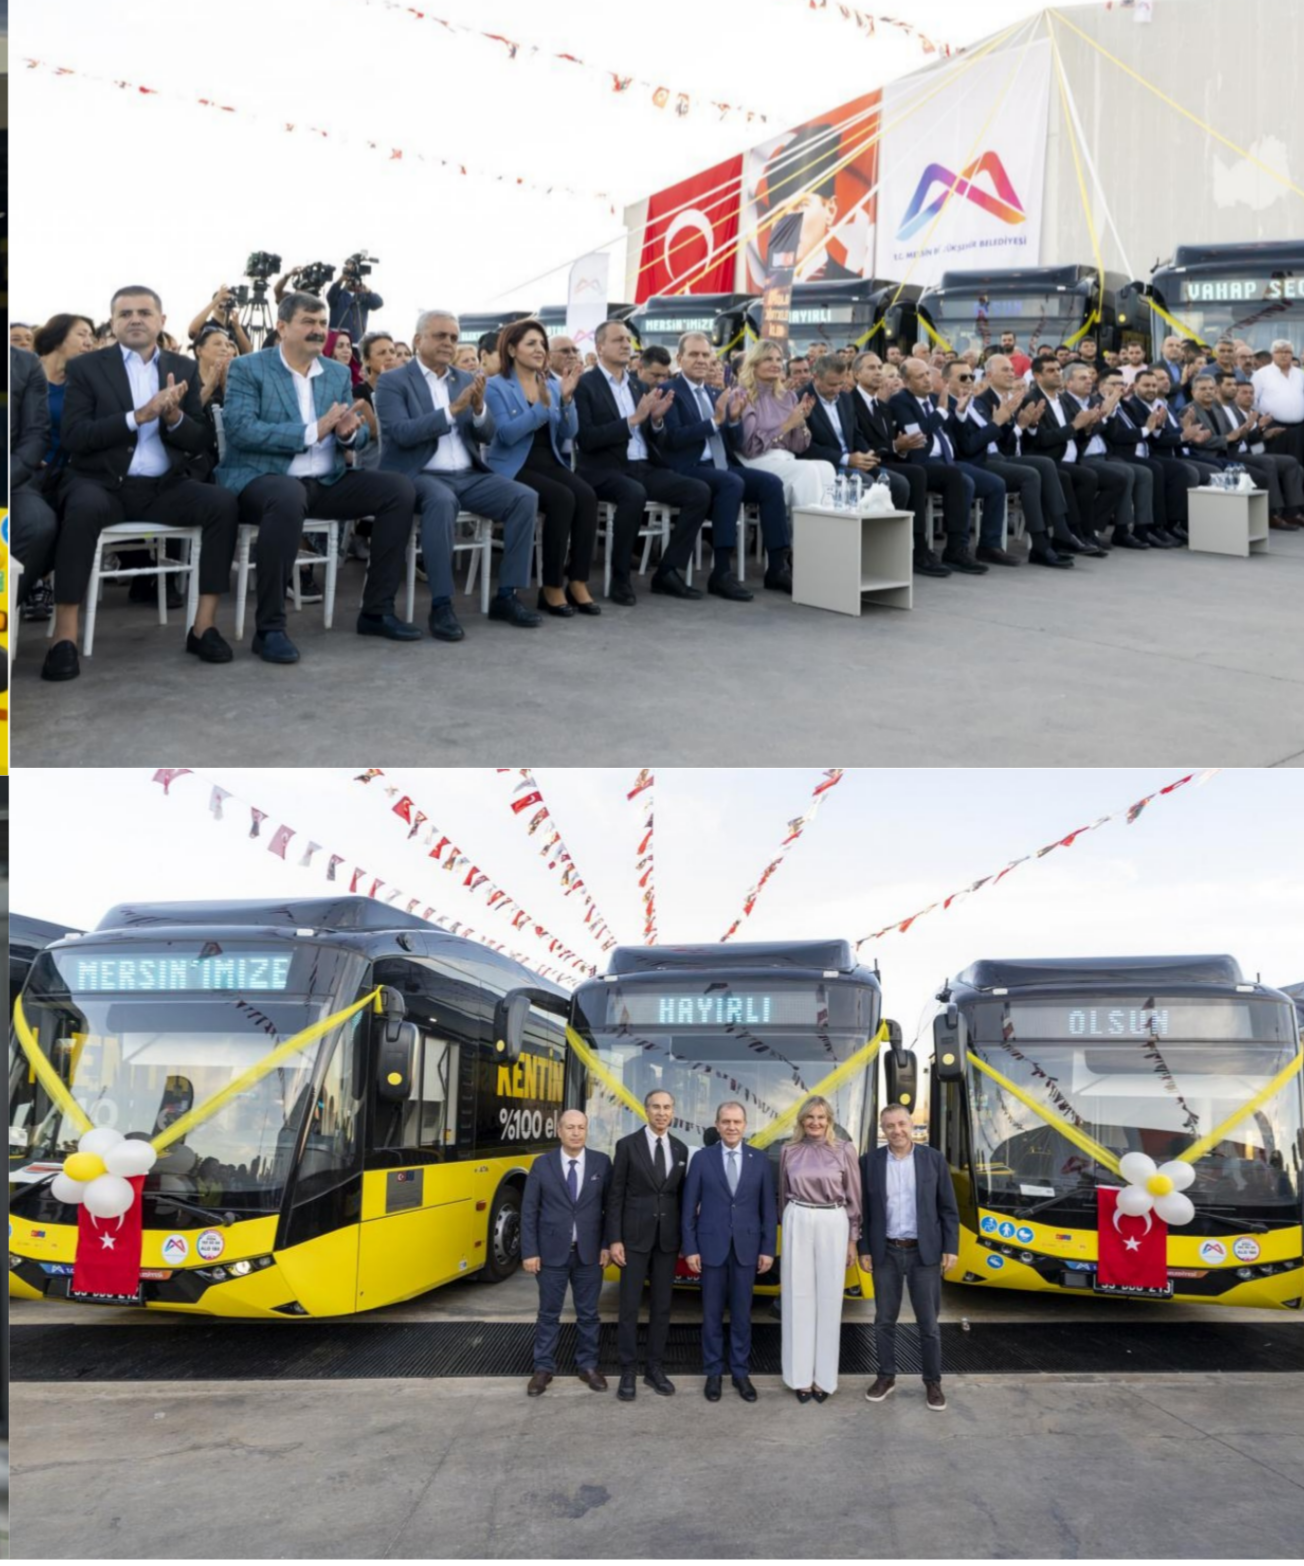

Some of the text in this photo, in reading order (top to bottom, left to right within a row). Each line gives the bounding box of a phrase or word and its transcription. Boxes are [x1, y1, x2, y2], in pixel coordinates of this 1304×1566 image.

[979, 235, 1027, 248] BELEDİYESİ
[1188, 282, 1256, 300] VAHAP
[789, 309, 832, 324] AYIRLI
[659, 997, 771, 1024] HAYIRLI
[1069, 1010, 1169, 1035] OLSUN
[499, 1108, 543, 1140] %100
